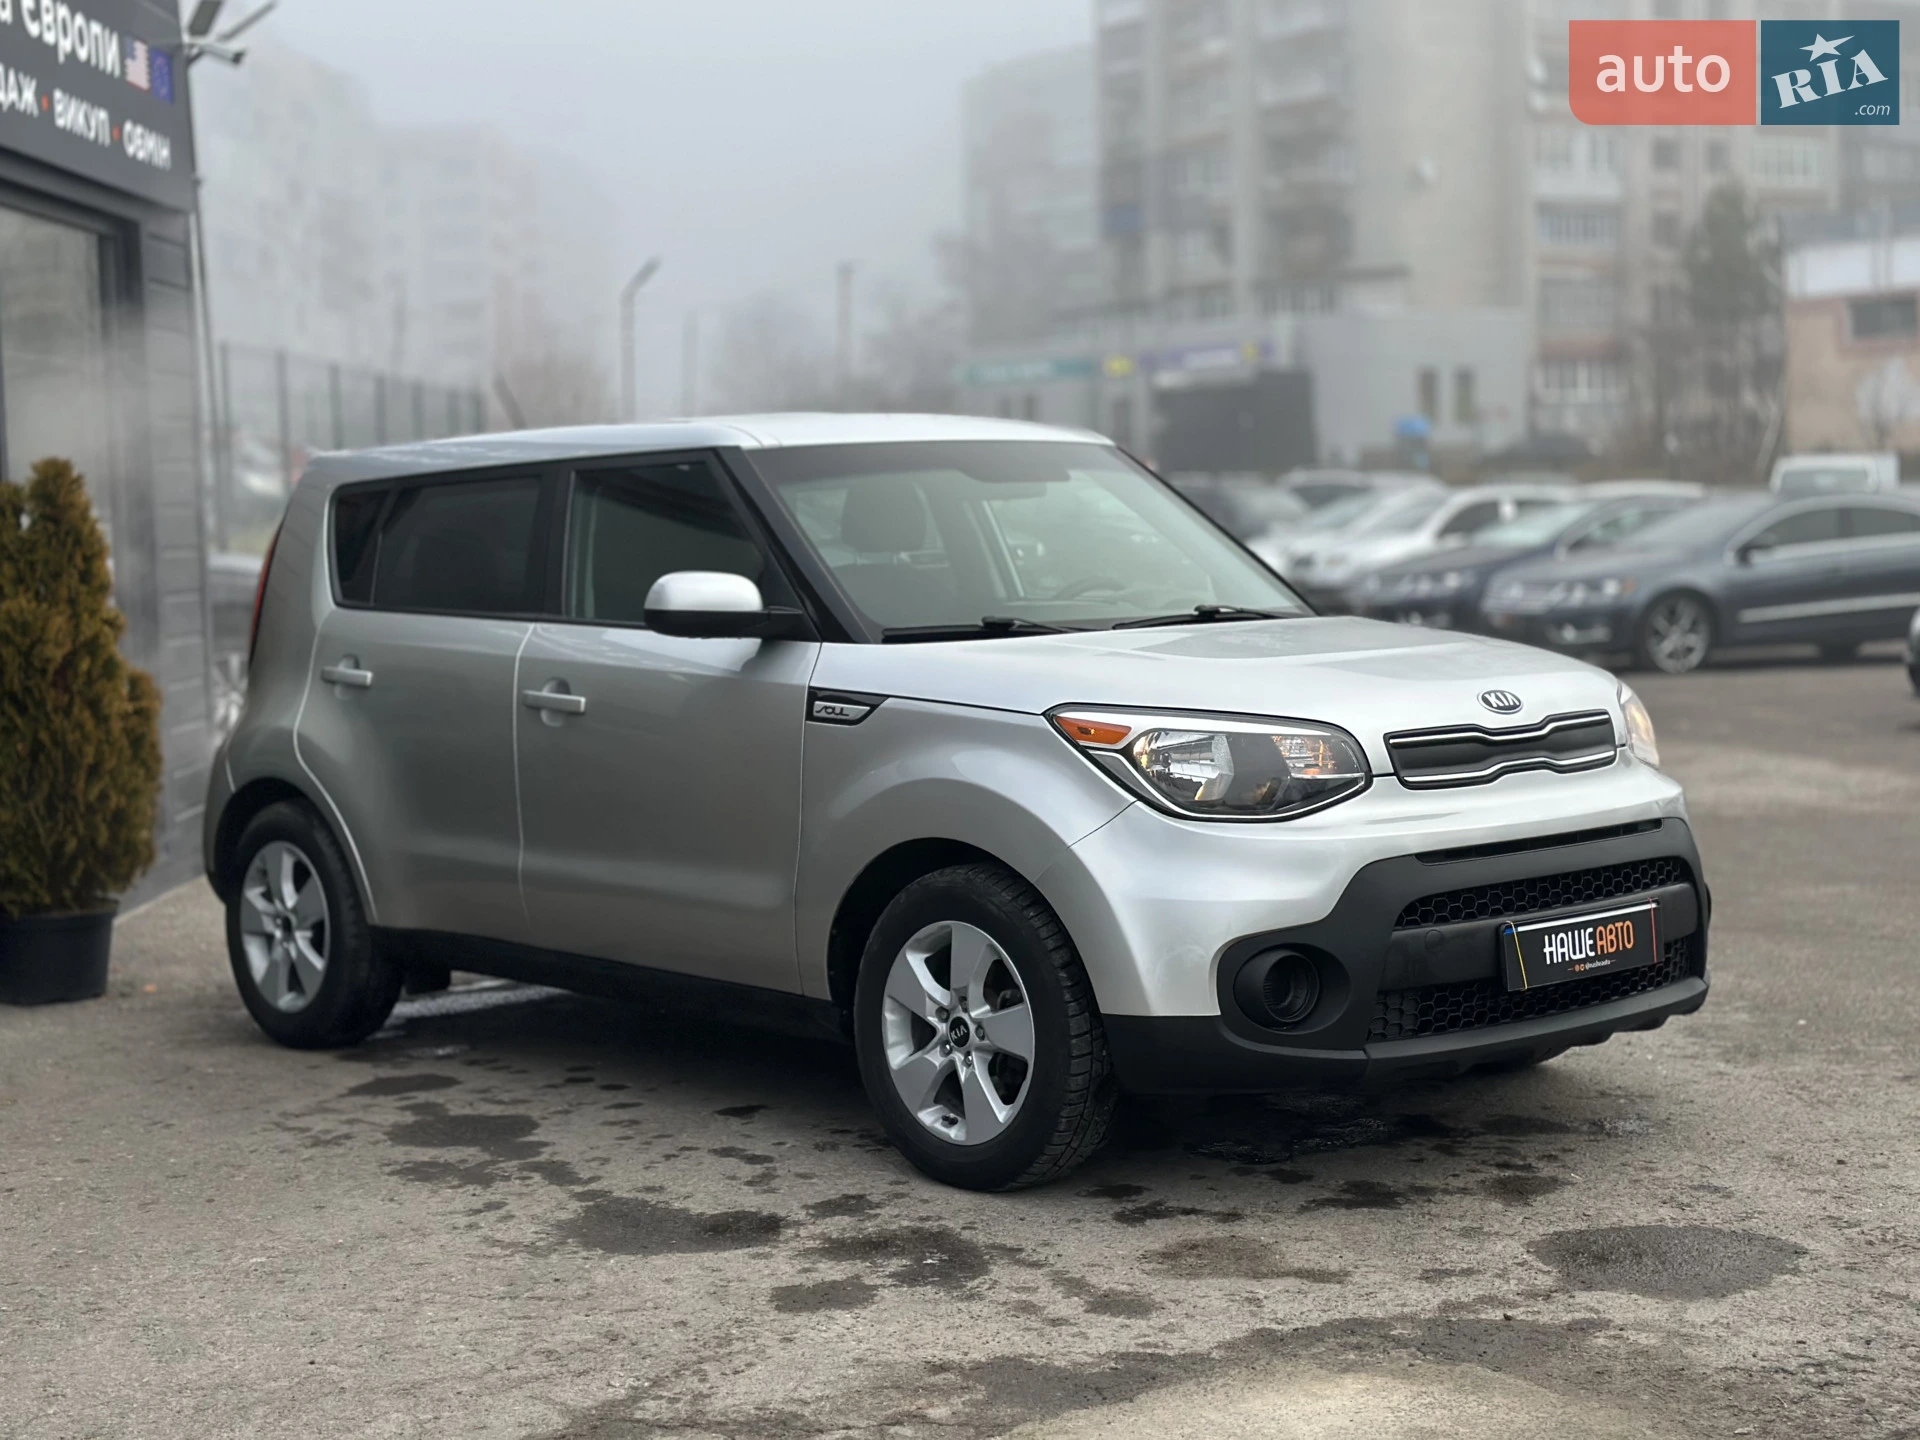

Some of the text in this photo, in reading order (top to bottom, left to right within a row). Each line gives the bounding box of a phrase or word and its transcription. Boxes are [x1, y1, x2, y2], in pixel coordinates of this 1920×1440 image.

[53, 87, 110, 147] ВИКУП
[1483, 691, 1520, 708] KIA
[1543, 920, 1635, 965] НАШЕ АВТО
[950, 1024, 968, 1041] KIA
